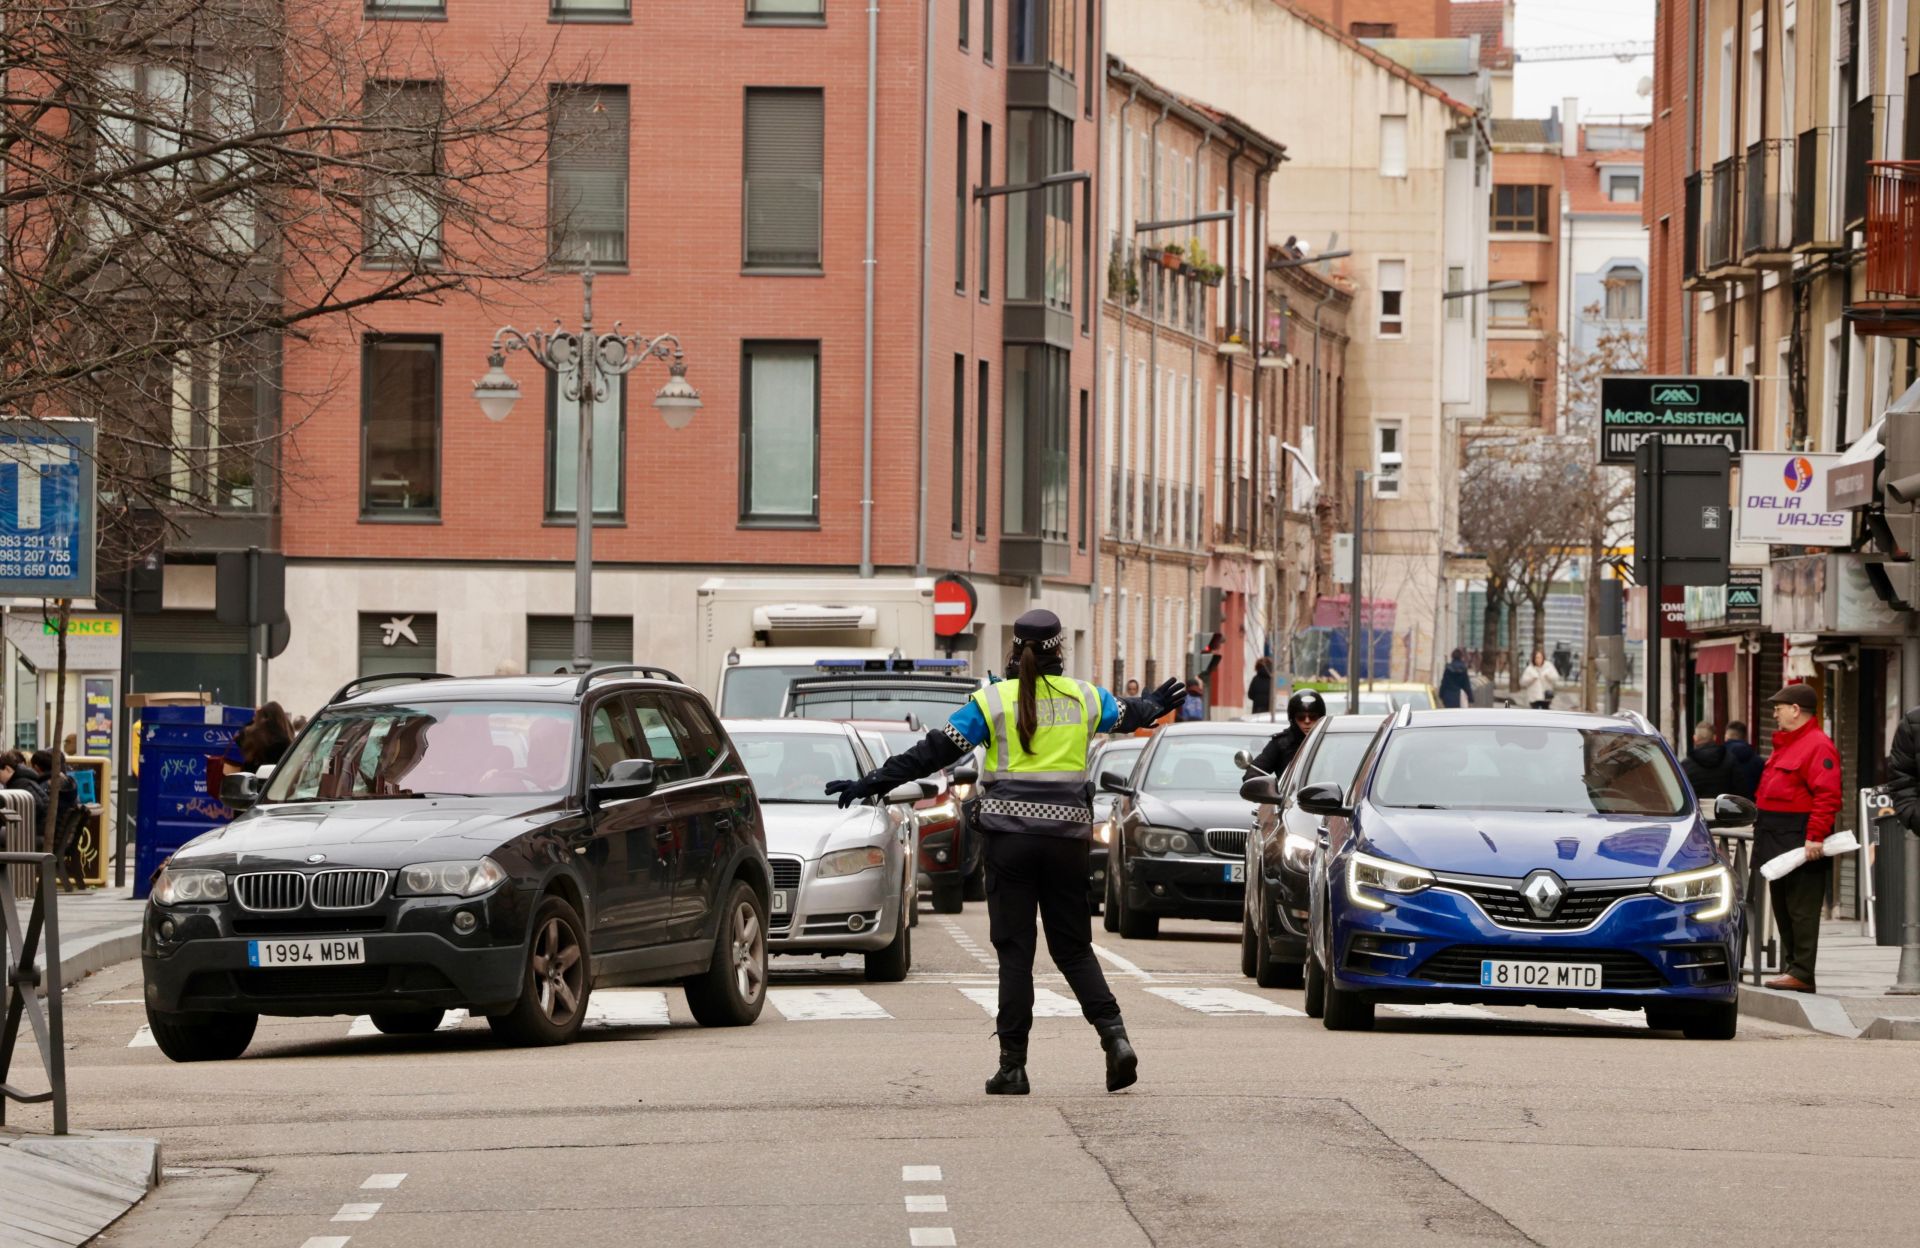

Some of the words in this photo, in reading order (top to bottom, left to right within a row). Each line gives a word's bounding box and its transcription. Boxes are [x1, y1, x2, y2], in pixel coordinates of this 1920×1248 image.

[1605, 409, 1744, 424] MICRO-ASISTENCIA
[1747, 496, 1801, 508] DELIA
[1777, 513, 1844, 526] VIAJES
[0, 536, 20, 548] 983
[24, 536, 44, 547] 291
[49, 536, 69, 548] 411
[0, 550, 20, 562] 983
[24, 550, 44, 562] 207
[49, 550, 70, 562] 755
[0, 565, 20, 576] 653
[24, 565, 45, 576] 659
[49, 565, 70, 576] 000
[67, 621, 113, 633] ONCE
[266, 943, 313, 962] 1994
[320, 942, 359, 961] MBM
[1497, 964, 1549, 985] 8102
[1557, 967, 1597, 987] MTD
